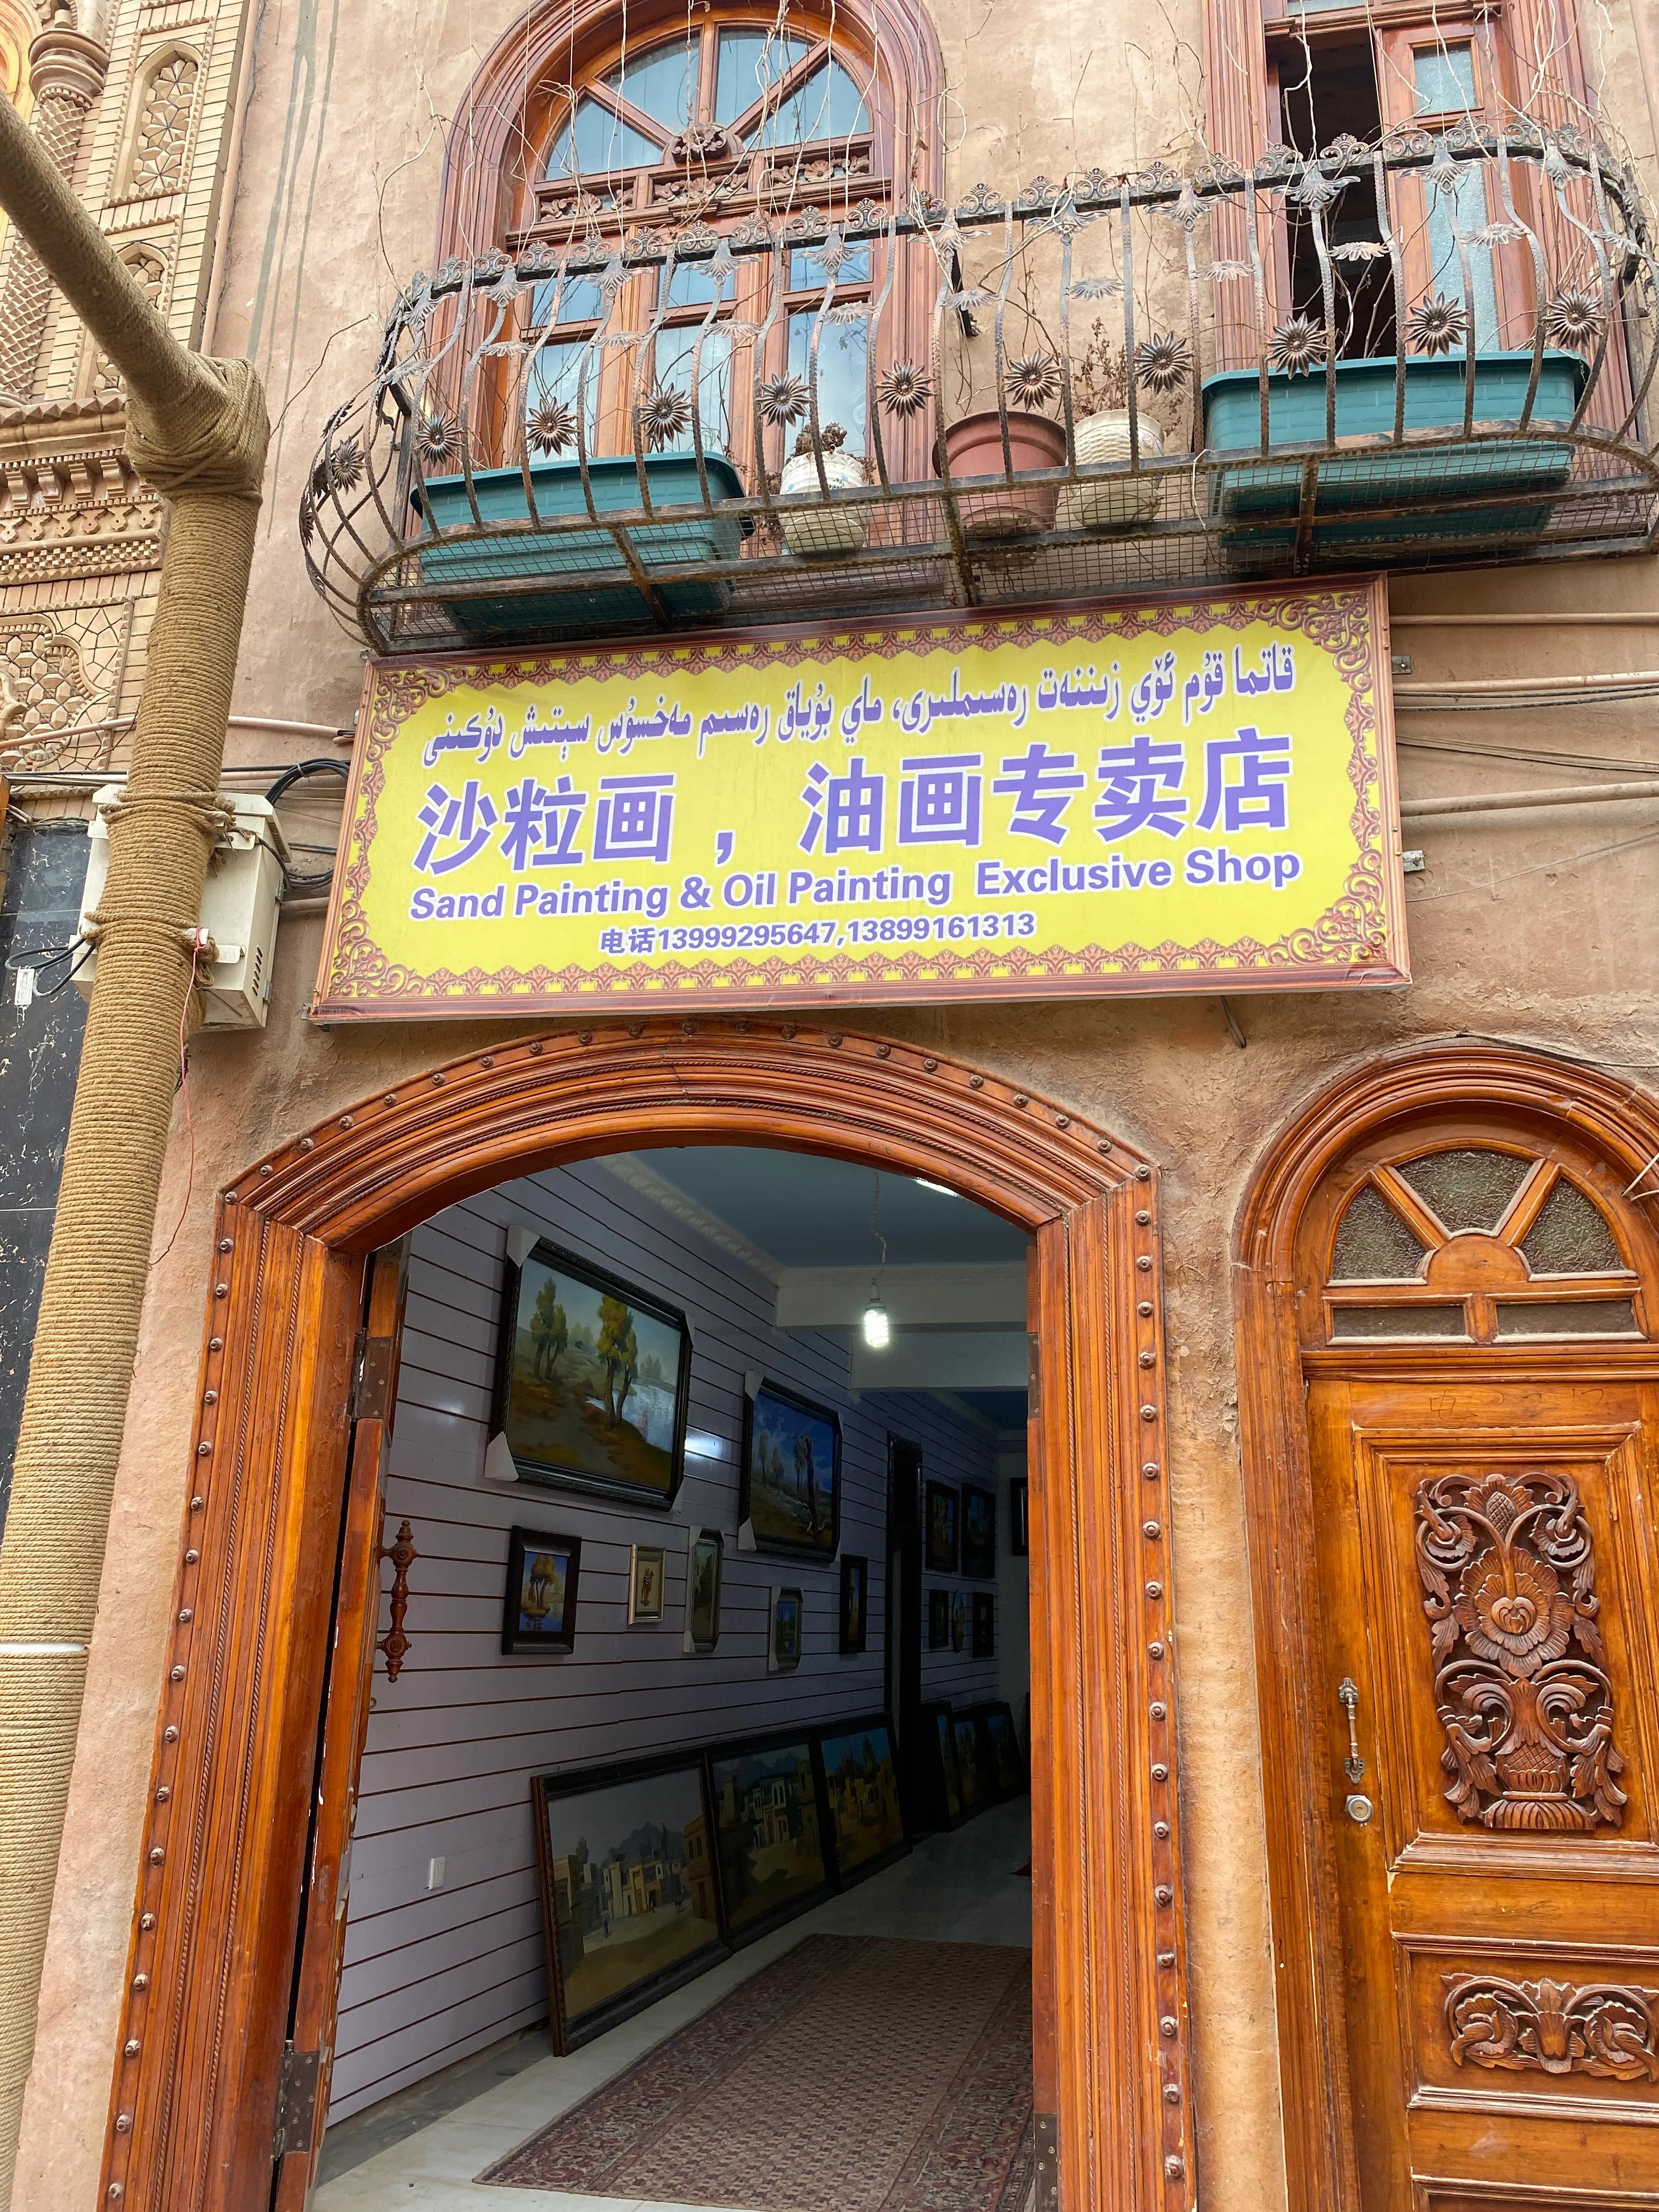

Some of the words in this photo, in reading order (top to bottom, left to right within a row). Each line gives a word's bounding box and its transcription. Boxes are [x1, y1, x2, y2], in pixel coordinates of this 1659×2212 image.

[1184, 652, 1224, 722] قۇم
[1235, 644, 1293, 695] قاتما
[597, 697, 691, 754] مەخسۇس
[698, 704, 769, 758] رەسىم
[778, 683, 832, 741] بۇياق
[842, 680, 882, 743] ماي
[799, 727, 1290, 854] 油画专卖店
[410, 885, 505, 919] Sand
[515, 881, 668, 918] Painting
[680, 876, 710, 909] &
[724, 873, 776, 907] Oil
[789, 866, 951, 905] Painting
[977, 854, 1172, 895] Exclusive
[1186, 848, 1300, 888] Shop
